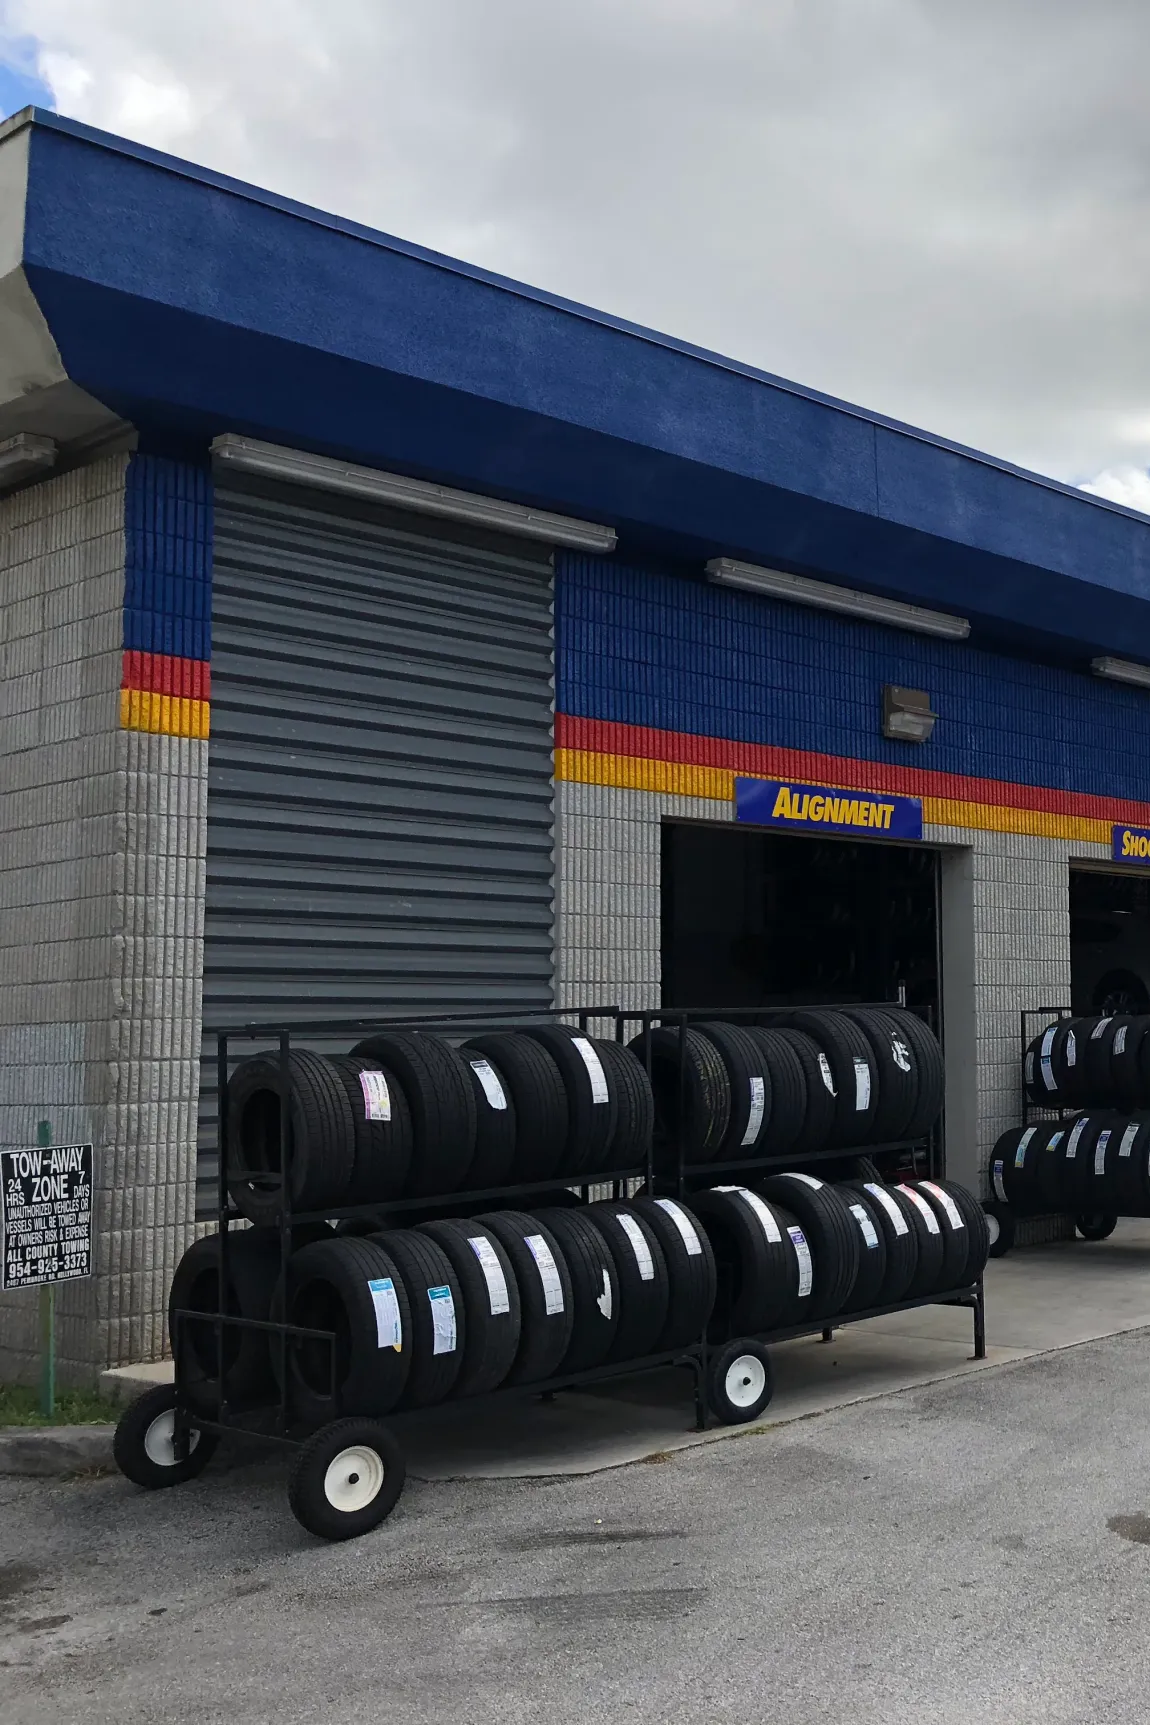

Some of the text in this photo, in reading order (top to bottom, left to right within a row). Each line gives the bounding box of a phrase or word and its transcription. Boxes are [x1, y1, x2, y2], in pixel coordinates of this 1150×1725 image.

[772, 787, 895, 829] ALIGNMENT
[10, 1147, 84, 1178] TOW-AWAY
[8, 1178, 22, 1193] 24
[32, 1174, 69, 1202] ZONE
[79, 1171, 86, 1184] 7
[6, 1192, 25, 1206] HRS
[74, 1184, 90, 1198] DAYS
[8, 1198, 89, 1220] UNAUTHORIZED VEHICLES OR
[6, 1219, 32, 1234] VESSELS
[34, 1217, 47, 1230] WILL
[49, 1216, 57, 1228] BE
[58, 1213, 77, 1227] TOWED
[9, 1225, 89, 1248] AT OWNERS RISK & EXPENSE
[7, 1238, 90, 1263] ALL COUNTY TOWING
[9, 1252, 87, 1279] 954-925-3373
